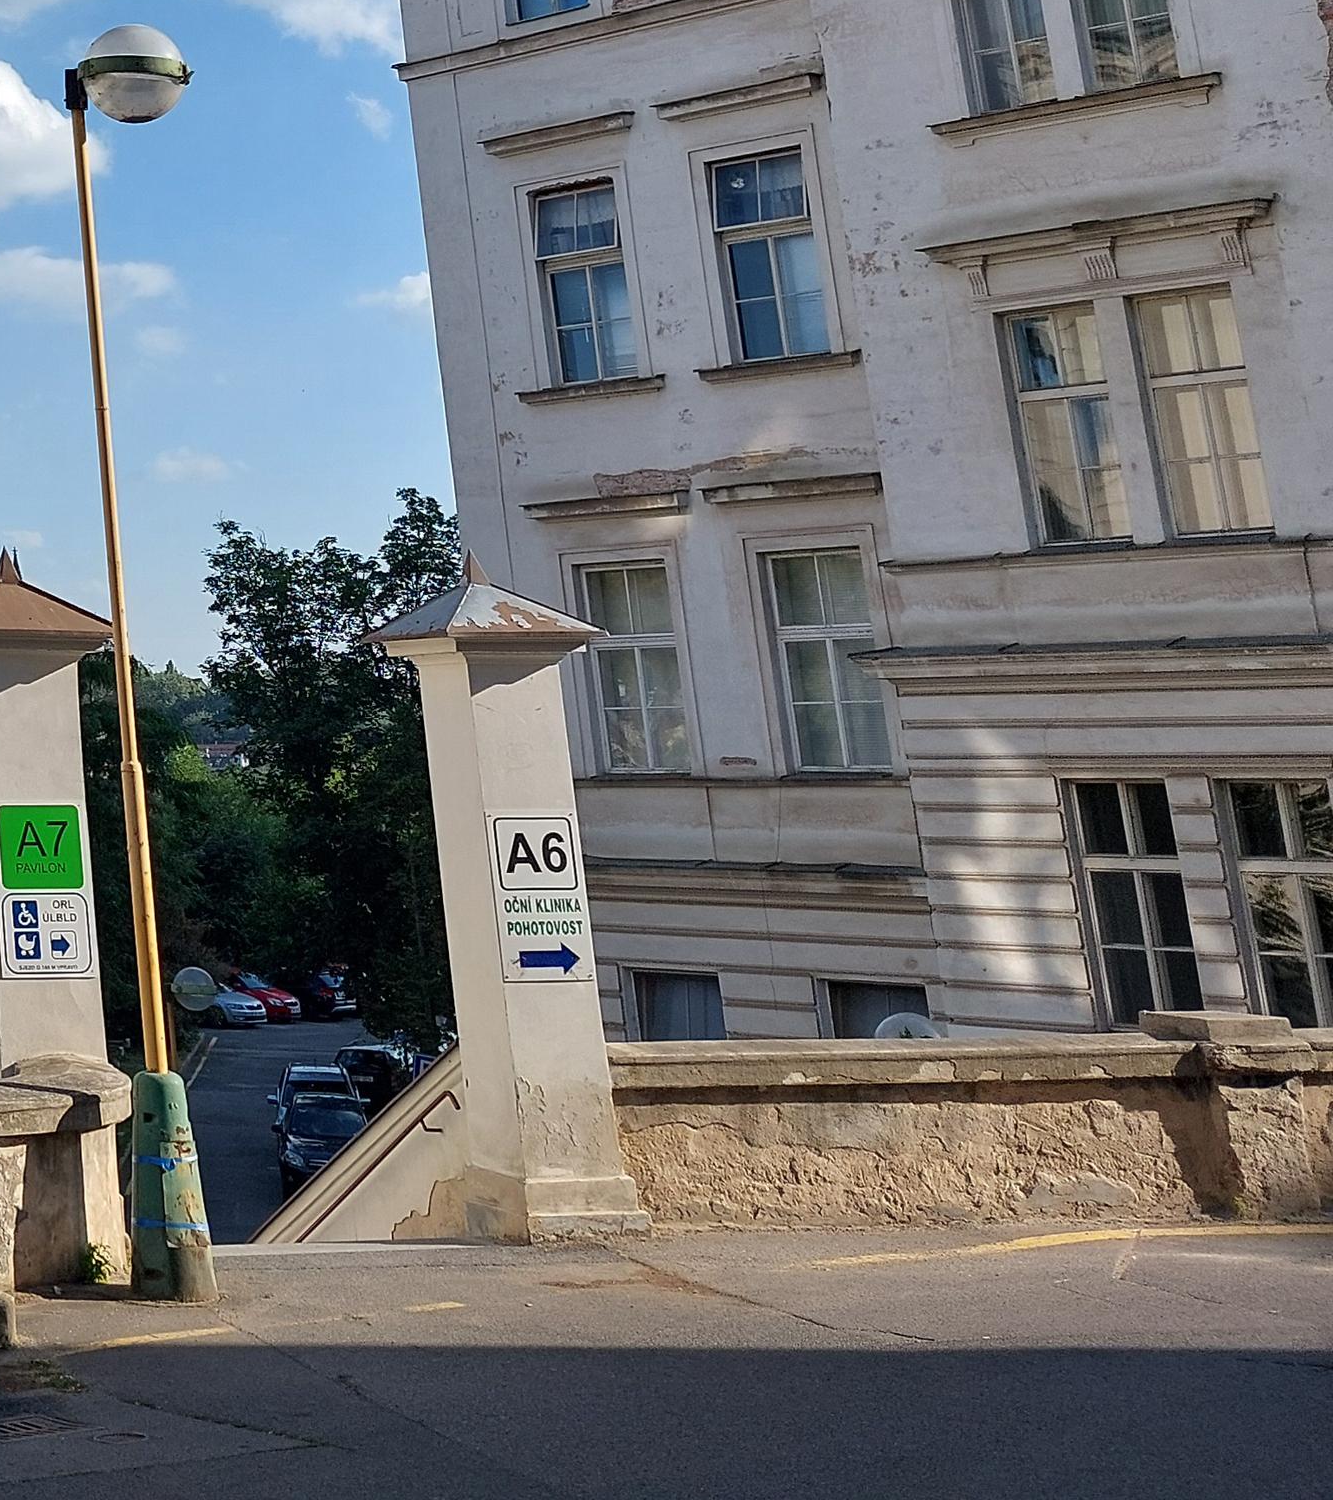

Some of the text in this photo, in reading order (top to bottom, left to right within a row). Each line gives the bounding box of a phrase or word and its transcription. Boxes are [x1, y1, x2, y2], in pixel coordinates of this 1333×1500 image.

[16, 820, 69, 857] A7
[506, 832, 567, 873] A6
[16, 862, 67, 874] PAVILON
[52, 900, 74, 910] ORL
[504, 895, 582, 913] OČNÍ KLINIKA
[42, 911, 77, 923] ÚLBLD
[507, 920, 583, 936] POHOTOVOST
